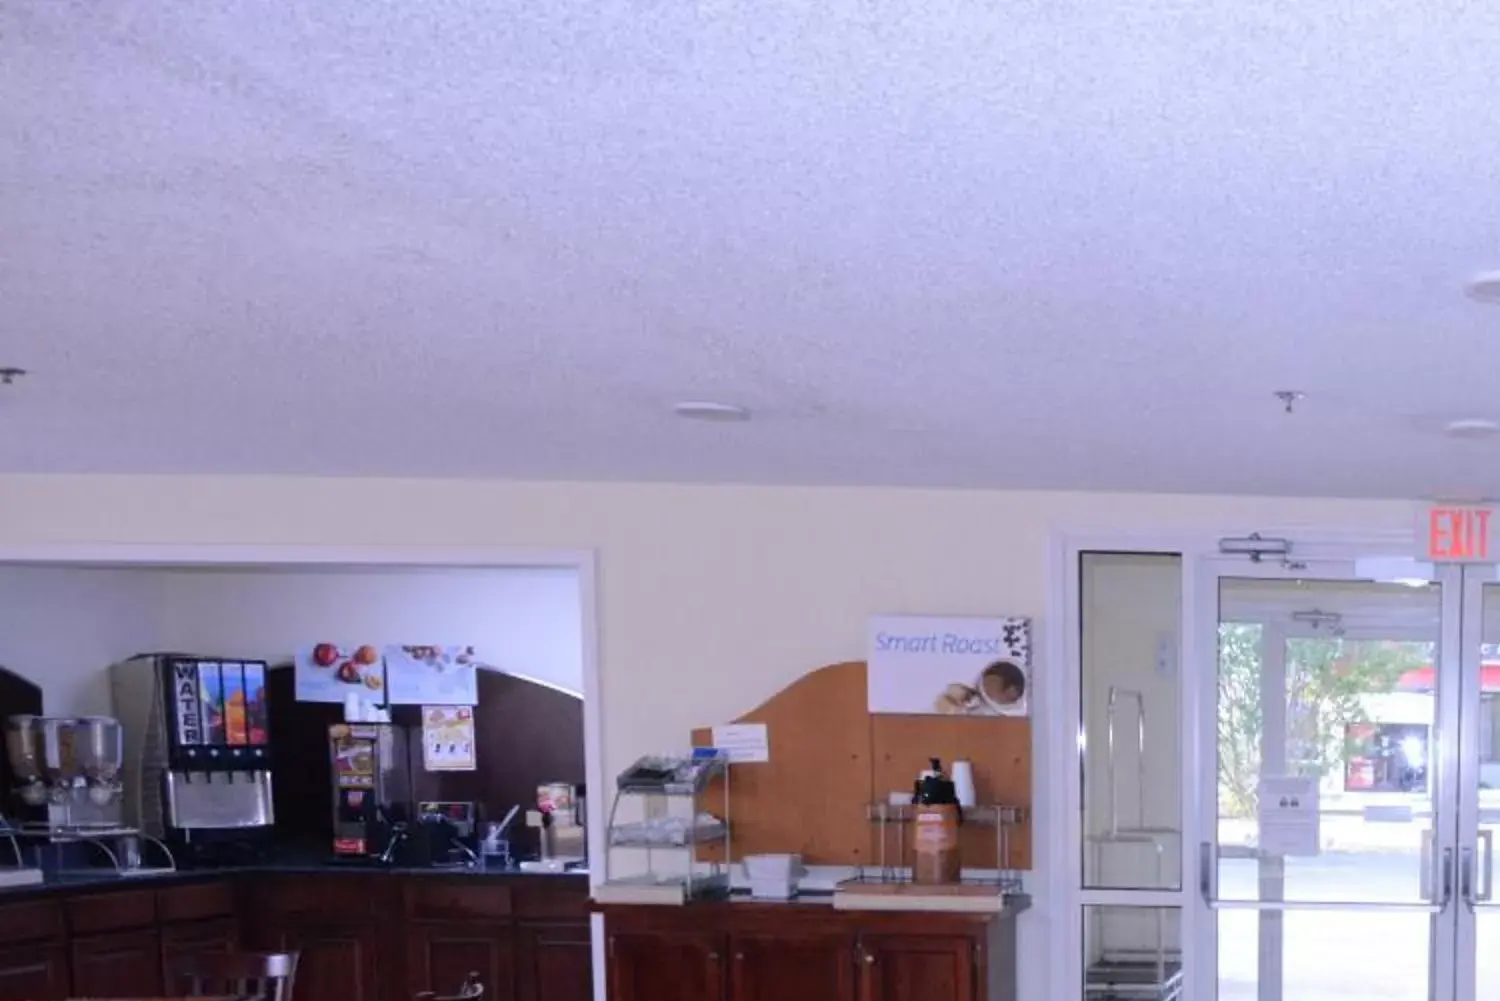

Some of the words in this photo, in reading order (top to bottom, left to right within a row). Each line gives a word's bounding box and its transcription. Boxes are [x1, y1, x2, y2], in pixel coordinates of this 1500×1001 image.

[1428, 508, 1494, 559] EXIT
[876, 631, 938, 653] Smart
[941, 633, 1000, 654] Roast
[175, 664, 198, 743] WATER
